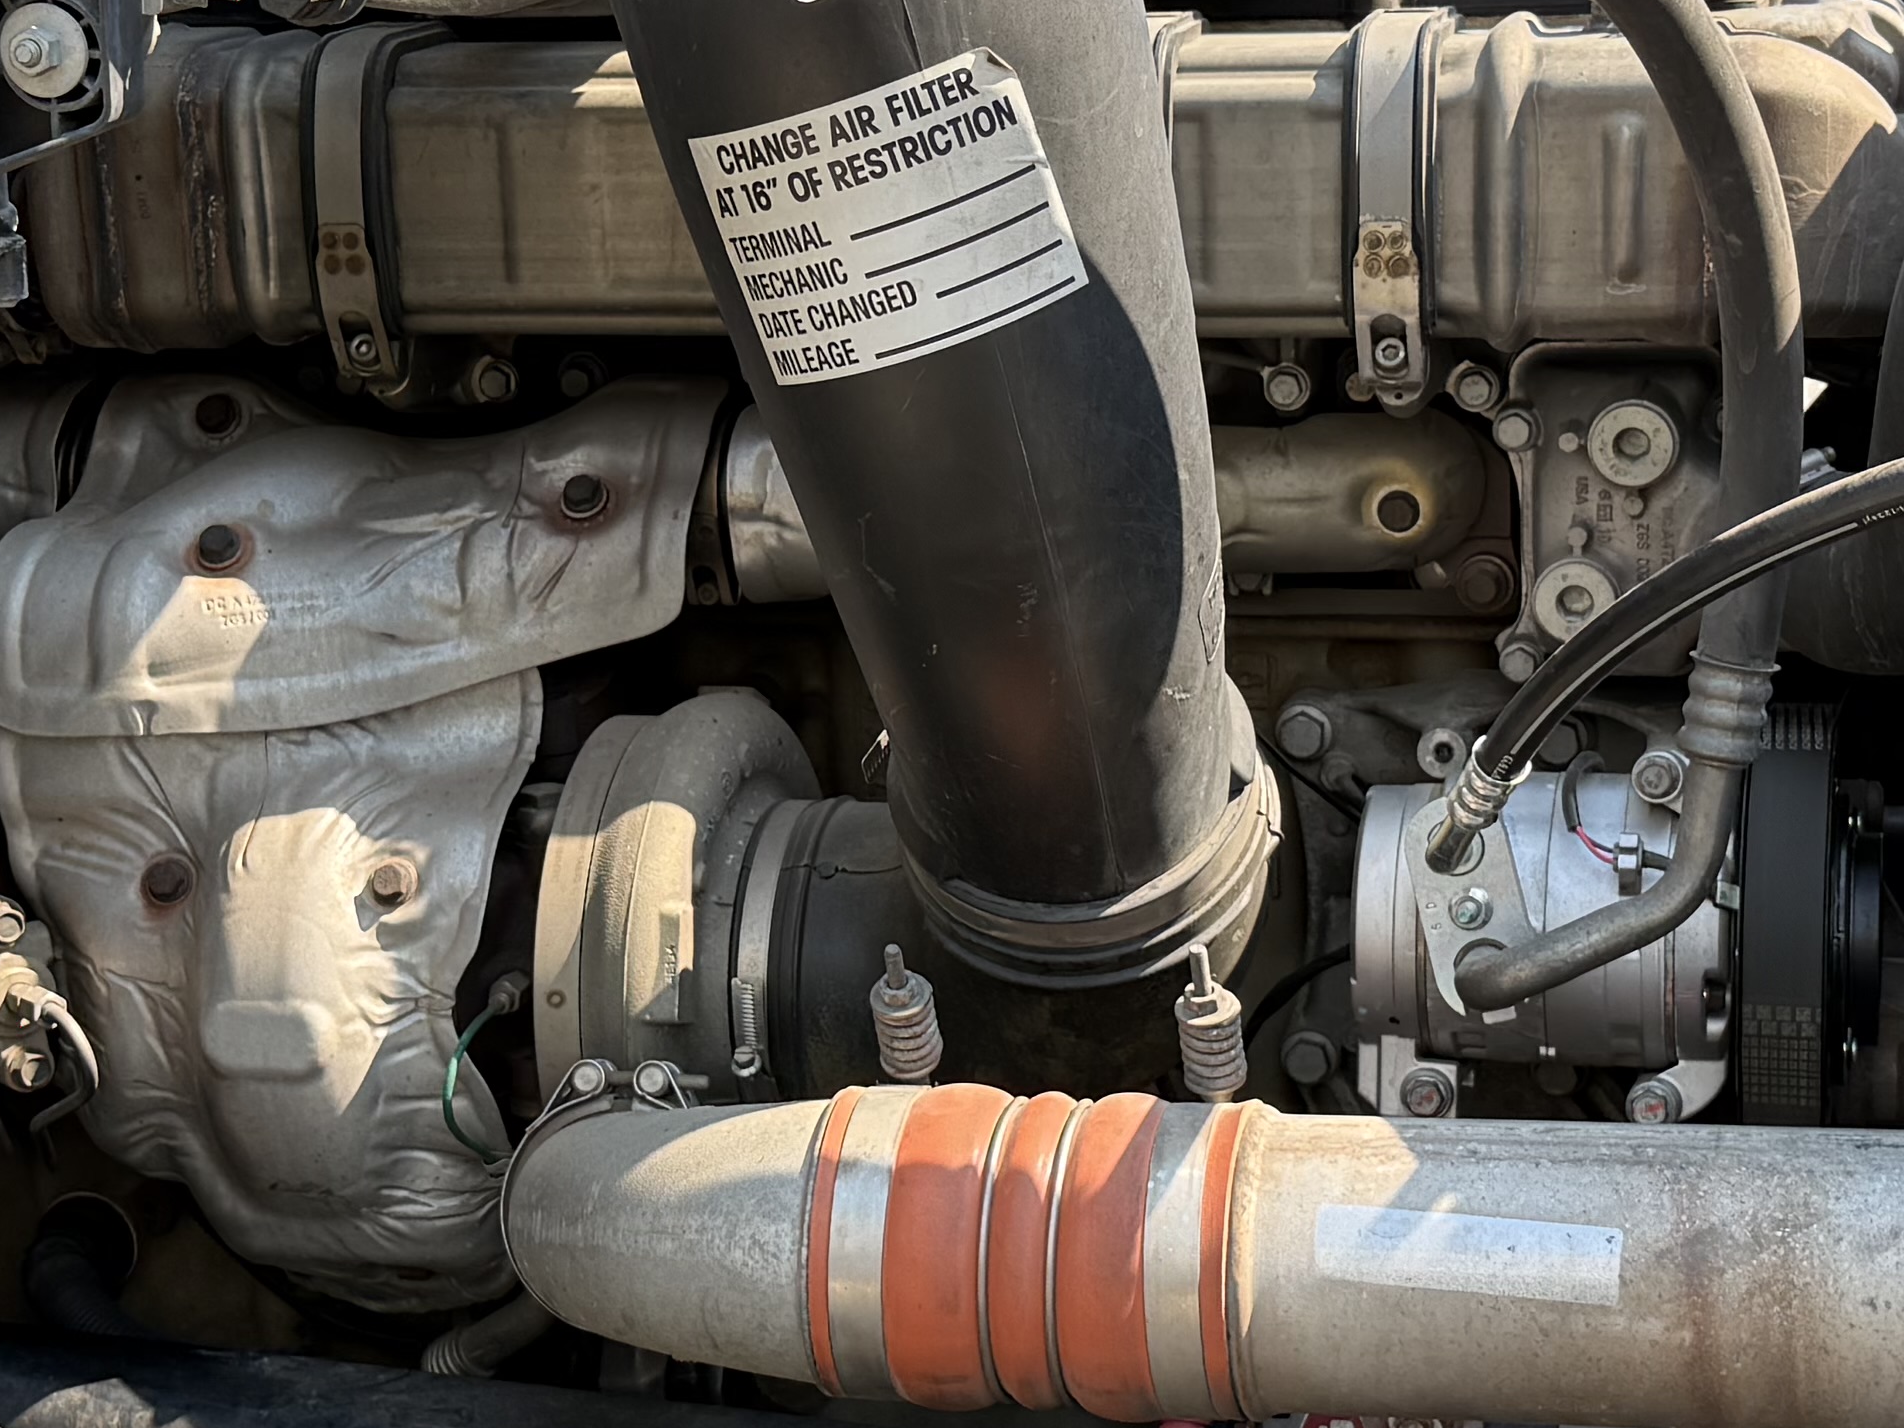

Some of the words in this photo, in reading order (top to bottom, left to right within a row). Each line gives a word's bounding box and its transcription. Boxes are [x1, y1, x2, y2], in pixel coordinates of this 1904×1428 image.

[715, 123, 820, 175] CHANGE
[830, 104, 883, 150] AIR
[886, 67, 980, 129] FILTER
[715, 188, 740, 219] AT
[788, 168, 824, 204] OF
[833, 95, 1019, 192] RESTRICTION
[728, 220, 832, 265] TERMINAL
[744, 257, 850, 302] MECHANIC
[758, 305, 805, 340] DATE
[808, 280, 919, 332] CHANGED
[772, 337, 860, 378] MILEAGE
[1575, 476, 1590, 506] USA
